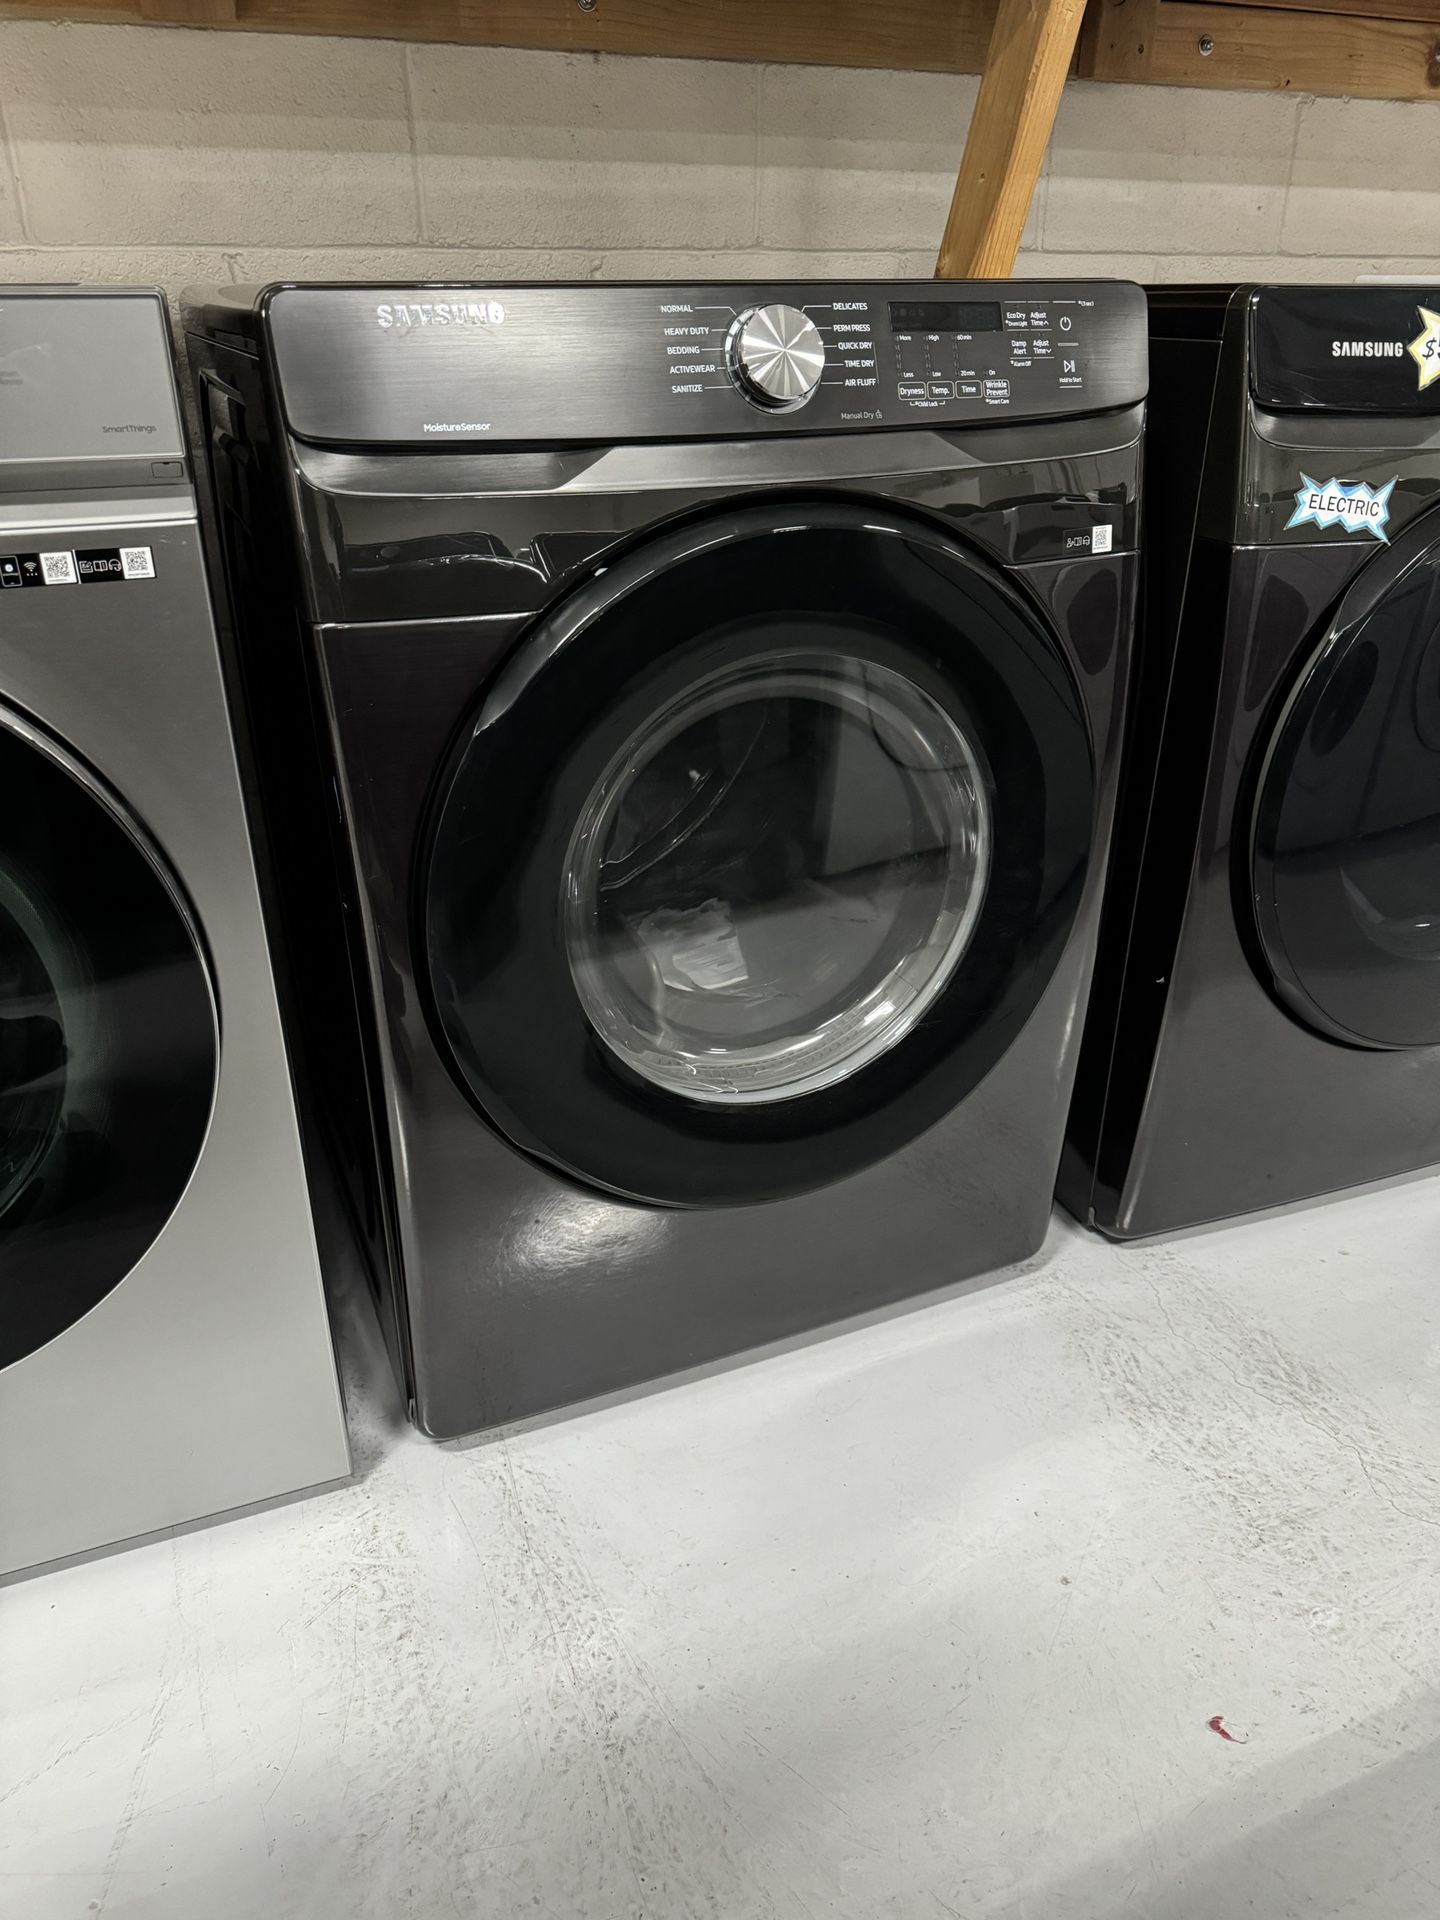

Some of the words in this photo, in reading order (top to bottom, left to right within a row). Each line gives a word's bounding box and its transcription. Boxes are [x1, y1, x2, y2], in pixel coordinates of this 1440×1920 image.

[852, 324, 870, 332] PRESS
[667, 346, 700, 354] BEDDING
[838, 342, 858, 350] QUICK
[1332, 341, 1404, 357] SAMSUNG
[844, 360, 859, 368] TIME
[670, 365, 715, 374] ACTIVEWEAR
[857, 378, 876, 386] FLUFF
[672, 385, 703, 393] SANITIZE
[900, 387, 924, 395] Dryness
[841, 412, 863, 420] Manual
[864, 412, 874, 420] Dry
[102, 425, 157, 434] SmartThings
[1308, 494, 1380, 517] ELECTRIC
